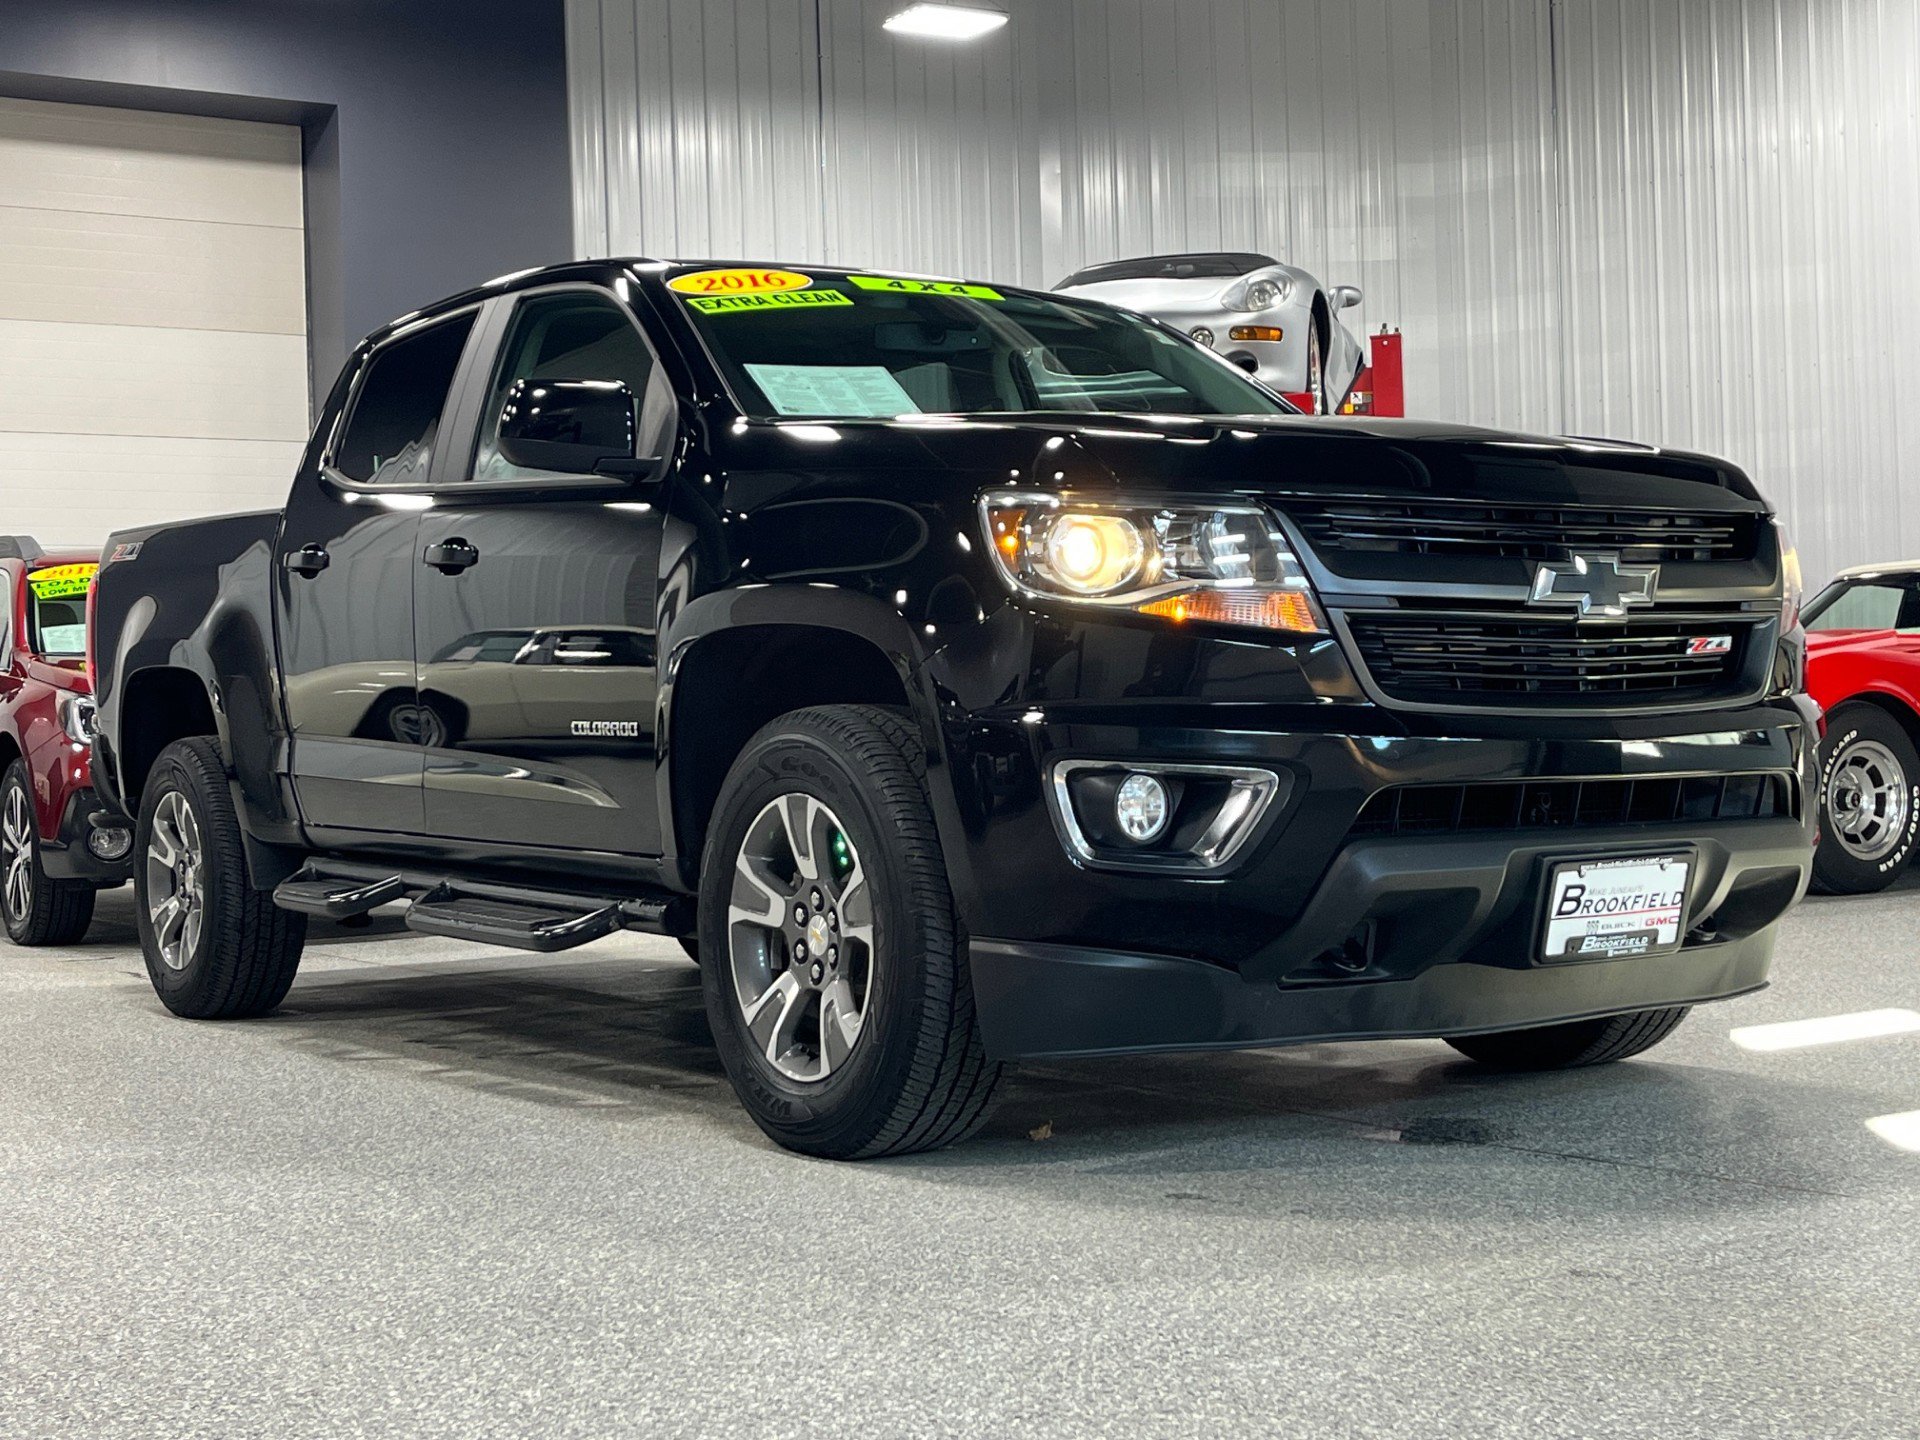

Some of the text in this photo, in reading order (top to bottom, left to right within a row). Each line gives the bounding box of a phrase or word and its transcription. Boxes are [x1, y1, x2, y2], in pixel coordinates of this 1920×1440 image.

[696, 272, 786, 291] 2016
[696, 292, 845, 310] EXTRA CLEAN
[36, 577, 91, 589] LOAD
[41, 587, 68, 597] LOW
[571, 721, 638, 737] COLORADO
[1820, 729, 1858, 805] STEELGARD
[1879, 785, 1920, 873] GOODYEAR
[1556, 884, 1684, 917] BROOKFIELD
[1601, 915, 1680, 931] BUICK GMC
[1581, 936, 1649, 951] BROOKFIELD
